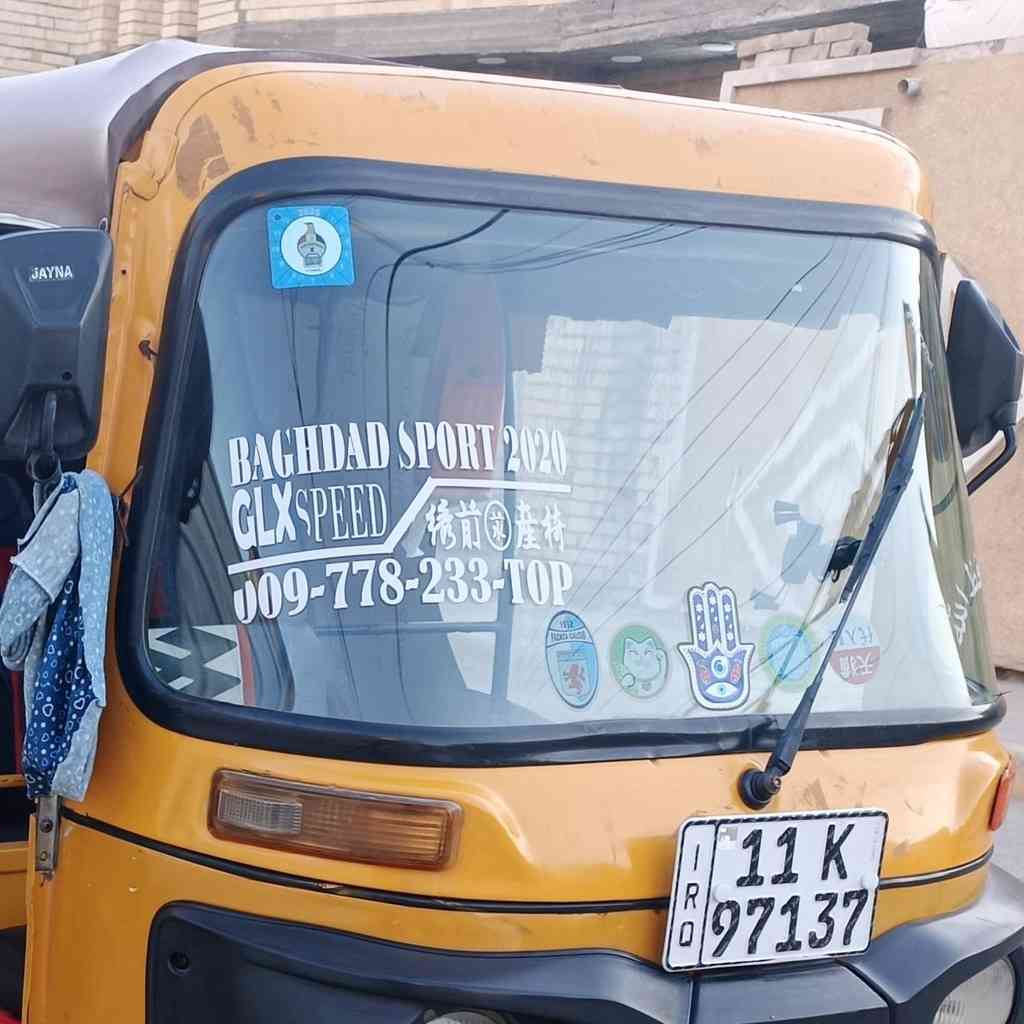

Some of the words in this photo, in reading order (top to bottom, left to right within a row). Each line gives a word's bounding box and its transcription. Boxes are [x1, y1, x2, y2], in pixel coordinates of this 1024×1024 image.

[228, 421, 390, 487] BAGHDAD
[397, 421, 495, 471] SPORT
[504, 424, 567, 475] 2020
[231, 482, 296, 550] GLX
[295, 483, 387, 541] SPEED
[736, 827, 799, 887] 11
[821, 824, 855, 880] K
[711, 889, 868, 957] 97137
